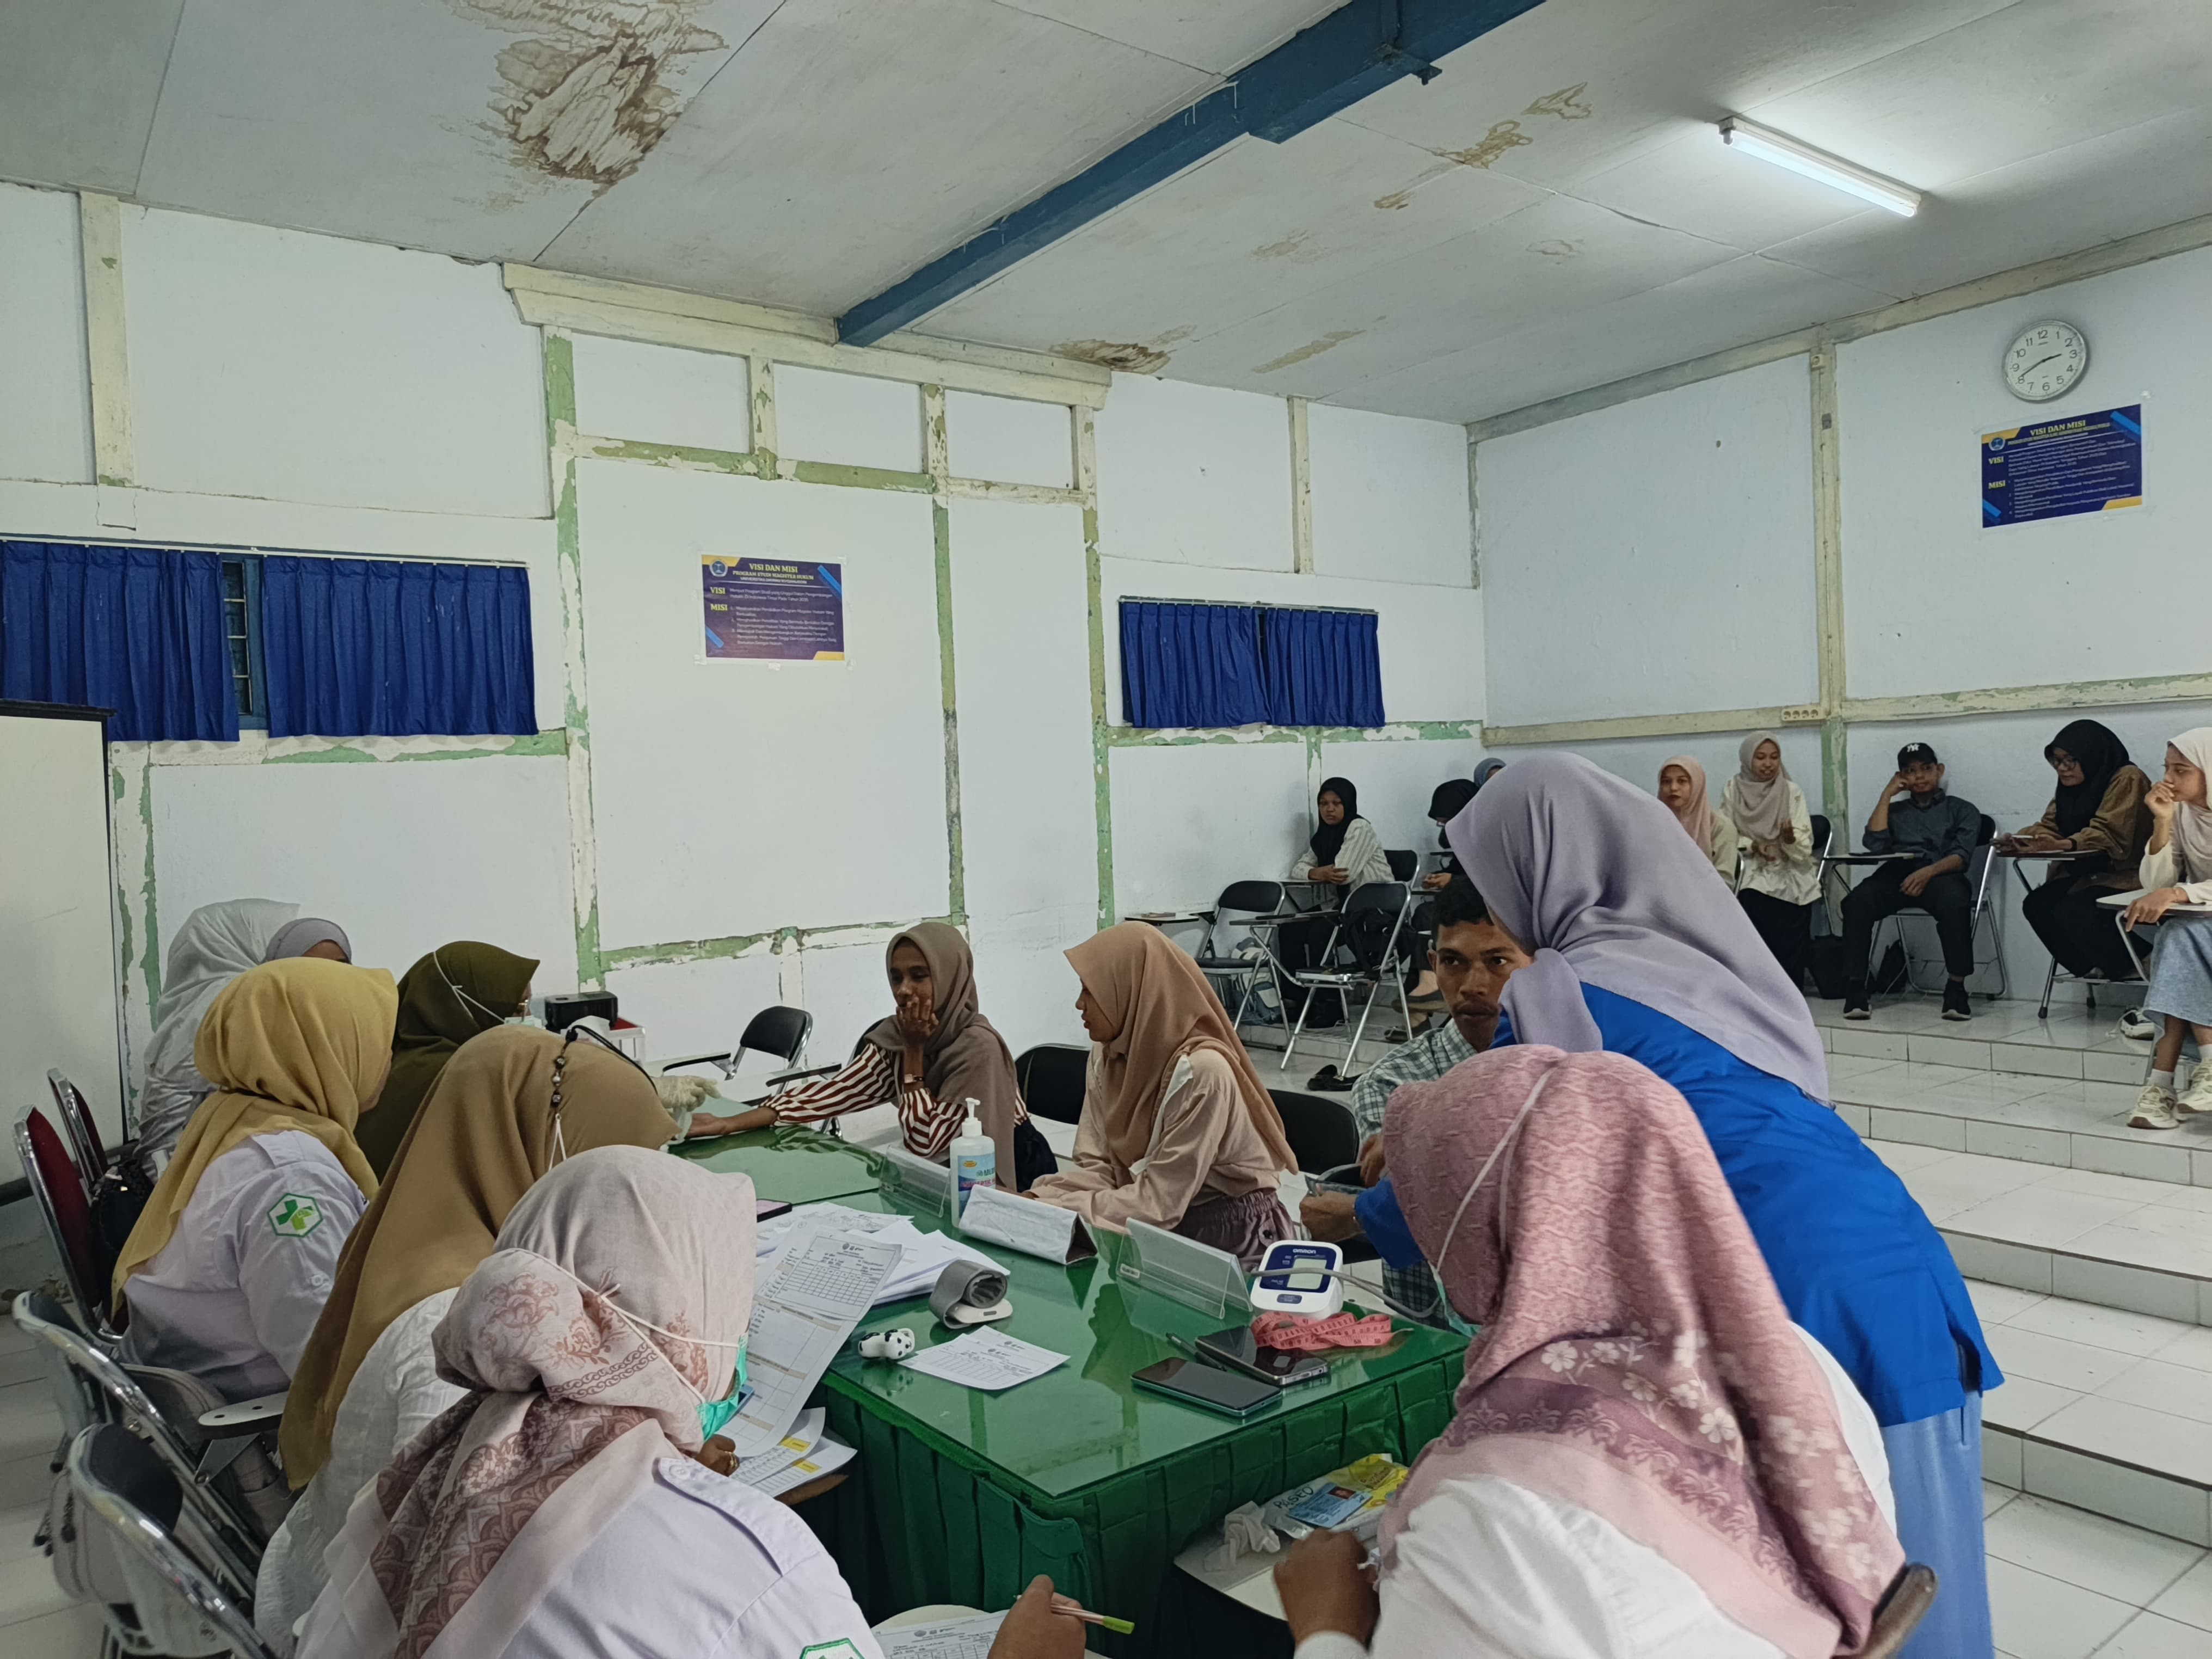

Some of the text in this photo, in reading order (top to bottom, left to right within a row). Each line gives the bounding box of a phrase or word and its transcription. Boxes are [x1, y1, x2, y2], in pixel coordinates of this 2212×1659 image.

[2037, 330, 2048, 339] 12
[2056, 331, 2060, 339] 1
[2025, 337, 2033, 346] 11
[2064, 337, 2073, 347] 2
[2016, 348, 2026, 358] 10
[2069, 349, 2077, 359] 3
[2012, 363, 2020, 372] 9
[2066, 364, 2074, 372] 4
[2018, 375, 2025, 384] 8
[2056, 375, 2064, 384] 5
[2027, 382, 2034, 391] 7
[2042, 382, 2050, 391] 6
[2030, 420, 2086, 436] VISI DAN MISI
[1988, 456, 2004, 465] VISI
[1988, 480, 2006, 489] MISI
[749, 563, 798, 573] VISI DAN MISI
[710, 604, 728, 612] MISI
